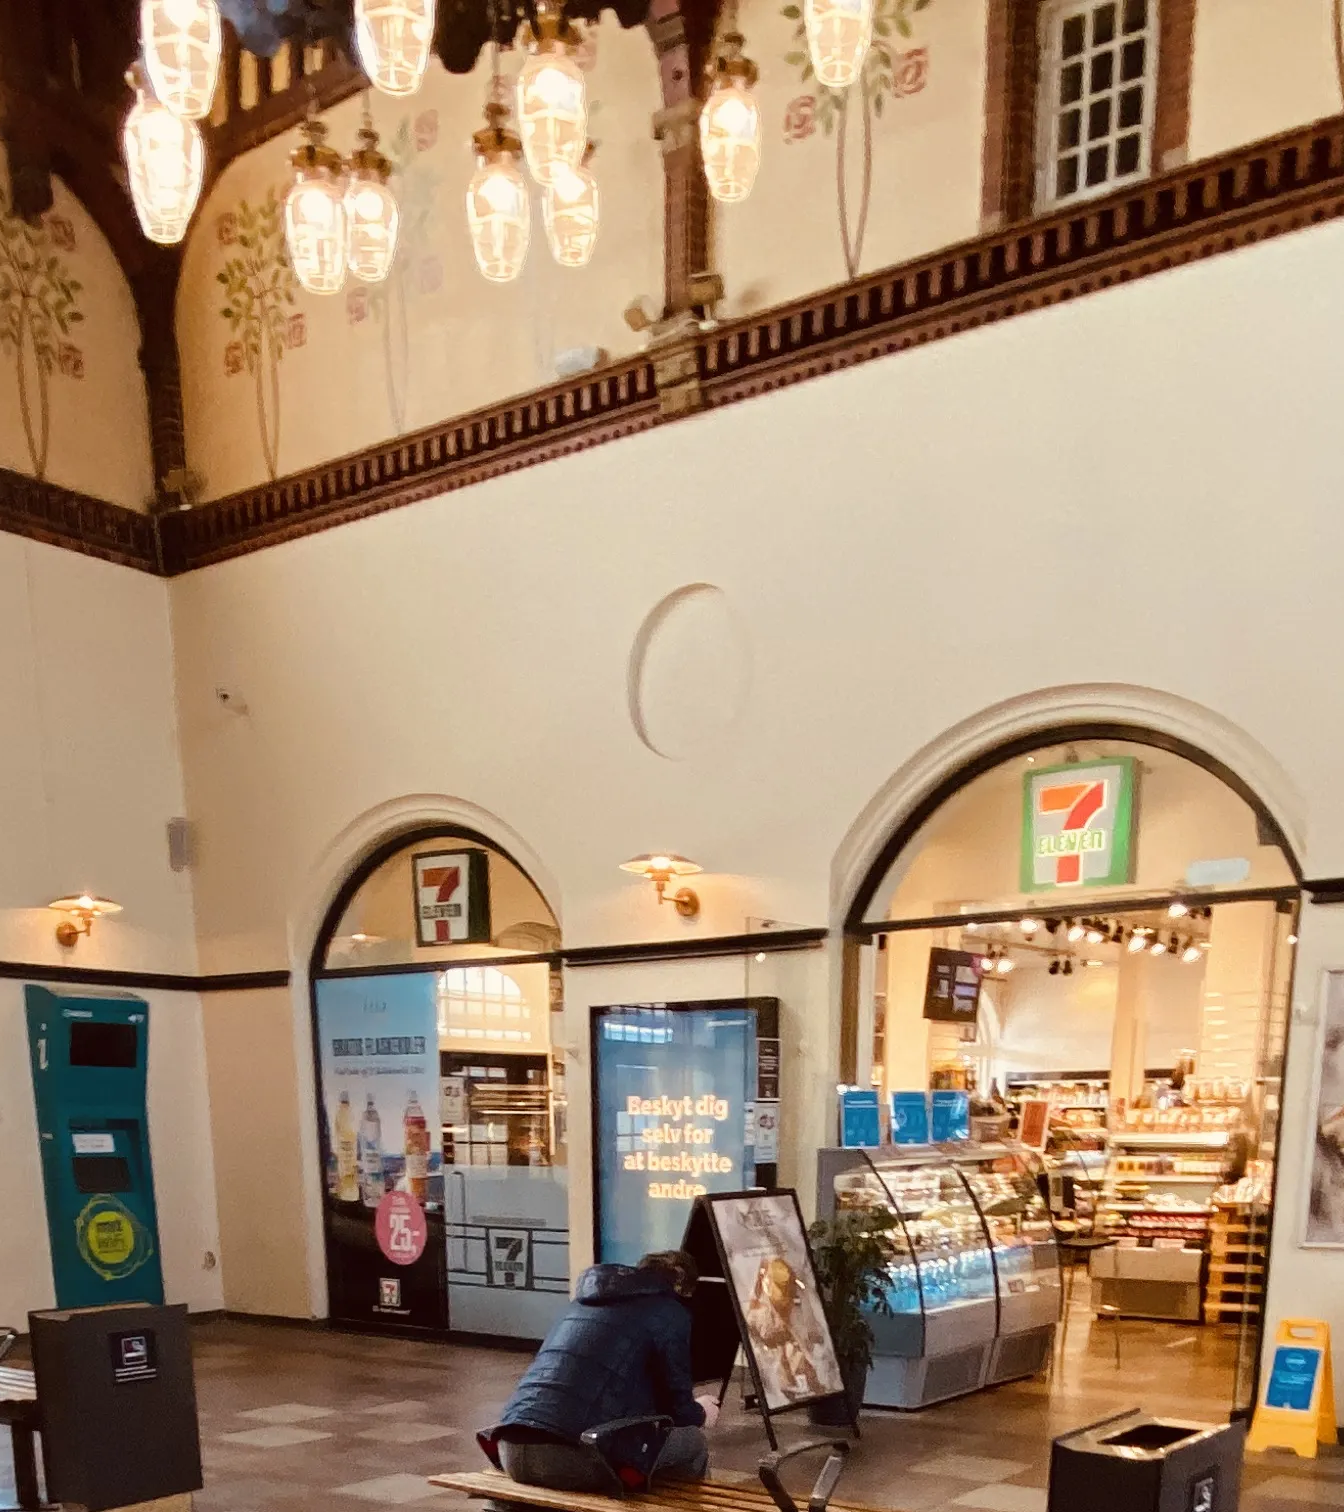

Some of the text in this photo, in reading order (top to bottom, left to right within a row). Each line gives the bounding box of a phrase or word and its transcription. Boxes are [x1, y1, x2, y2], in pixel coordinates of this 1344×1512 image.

[1038, 778, 1109, 886] 7
[421, 866, 460, 942] 7
[626, 1094, 729, 1121] Beskyt dig
[641, 1122, 714, 1144] selv for
[623, 1151, 733, 1178] at beskytte
[648, 1178, 707, 1199] andre
